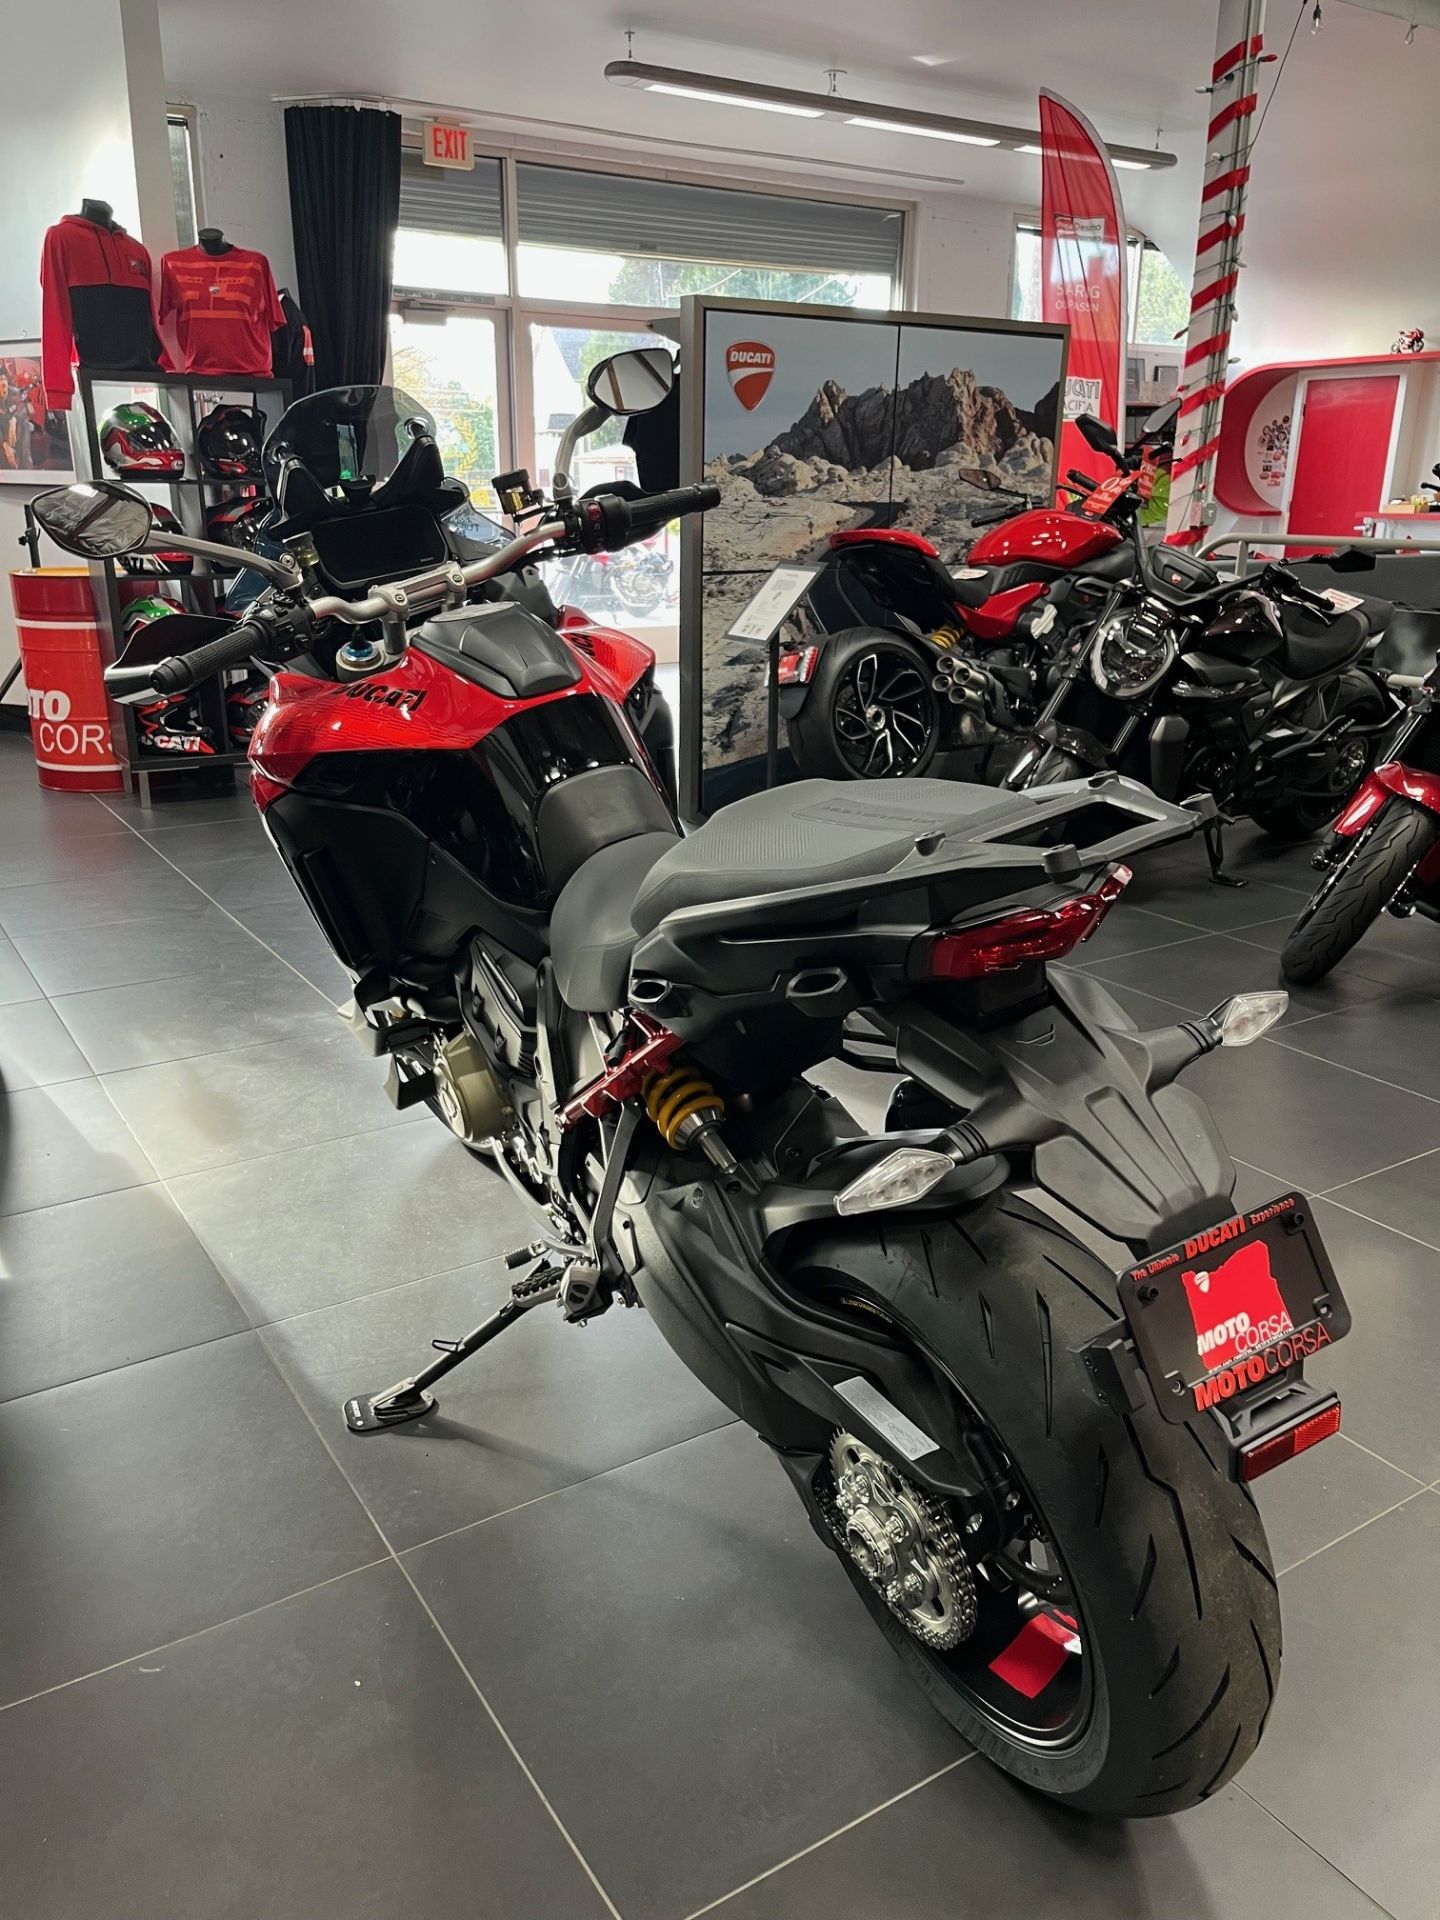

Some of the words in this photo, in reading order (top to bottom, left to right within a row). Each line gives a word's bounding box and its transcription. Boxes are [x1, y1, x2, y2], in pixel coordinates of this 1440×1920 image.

[432, 127, 467, 160] EXIT
[730, 351, 772, 364] DUCATI
[1130, 1266, 1147, 1282] The
[1148, 1253, 1180, 1274] Ultimate
[1183, 1215, 1246, 1260] DUCATI
[1249, 1198, 1296, 1226] Experience
[1196, 1311, 1251, 1356] MOTO
[1234, 1310, 1294, 1353] CORSA
